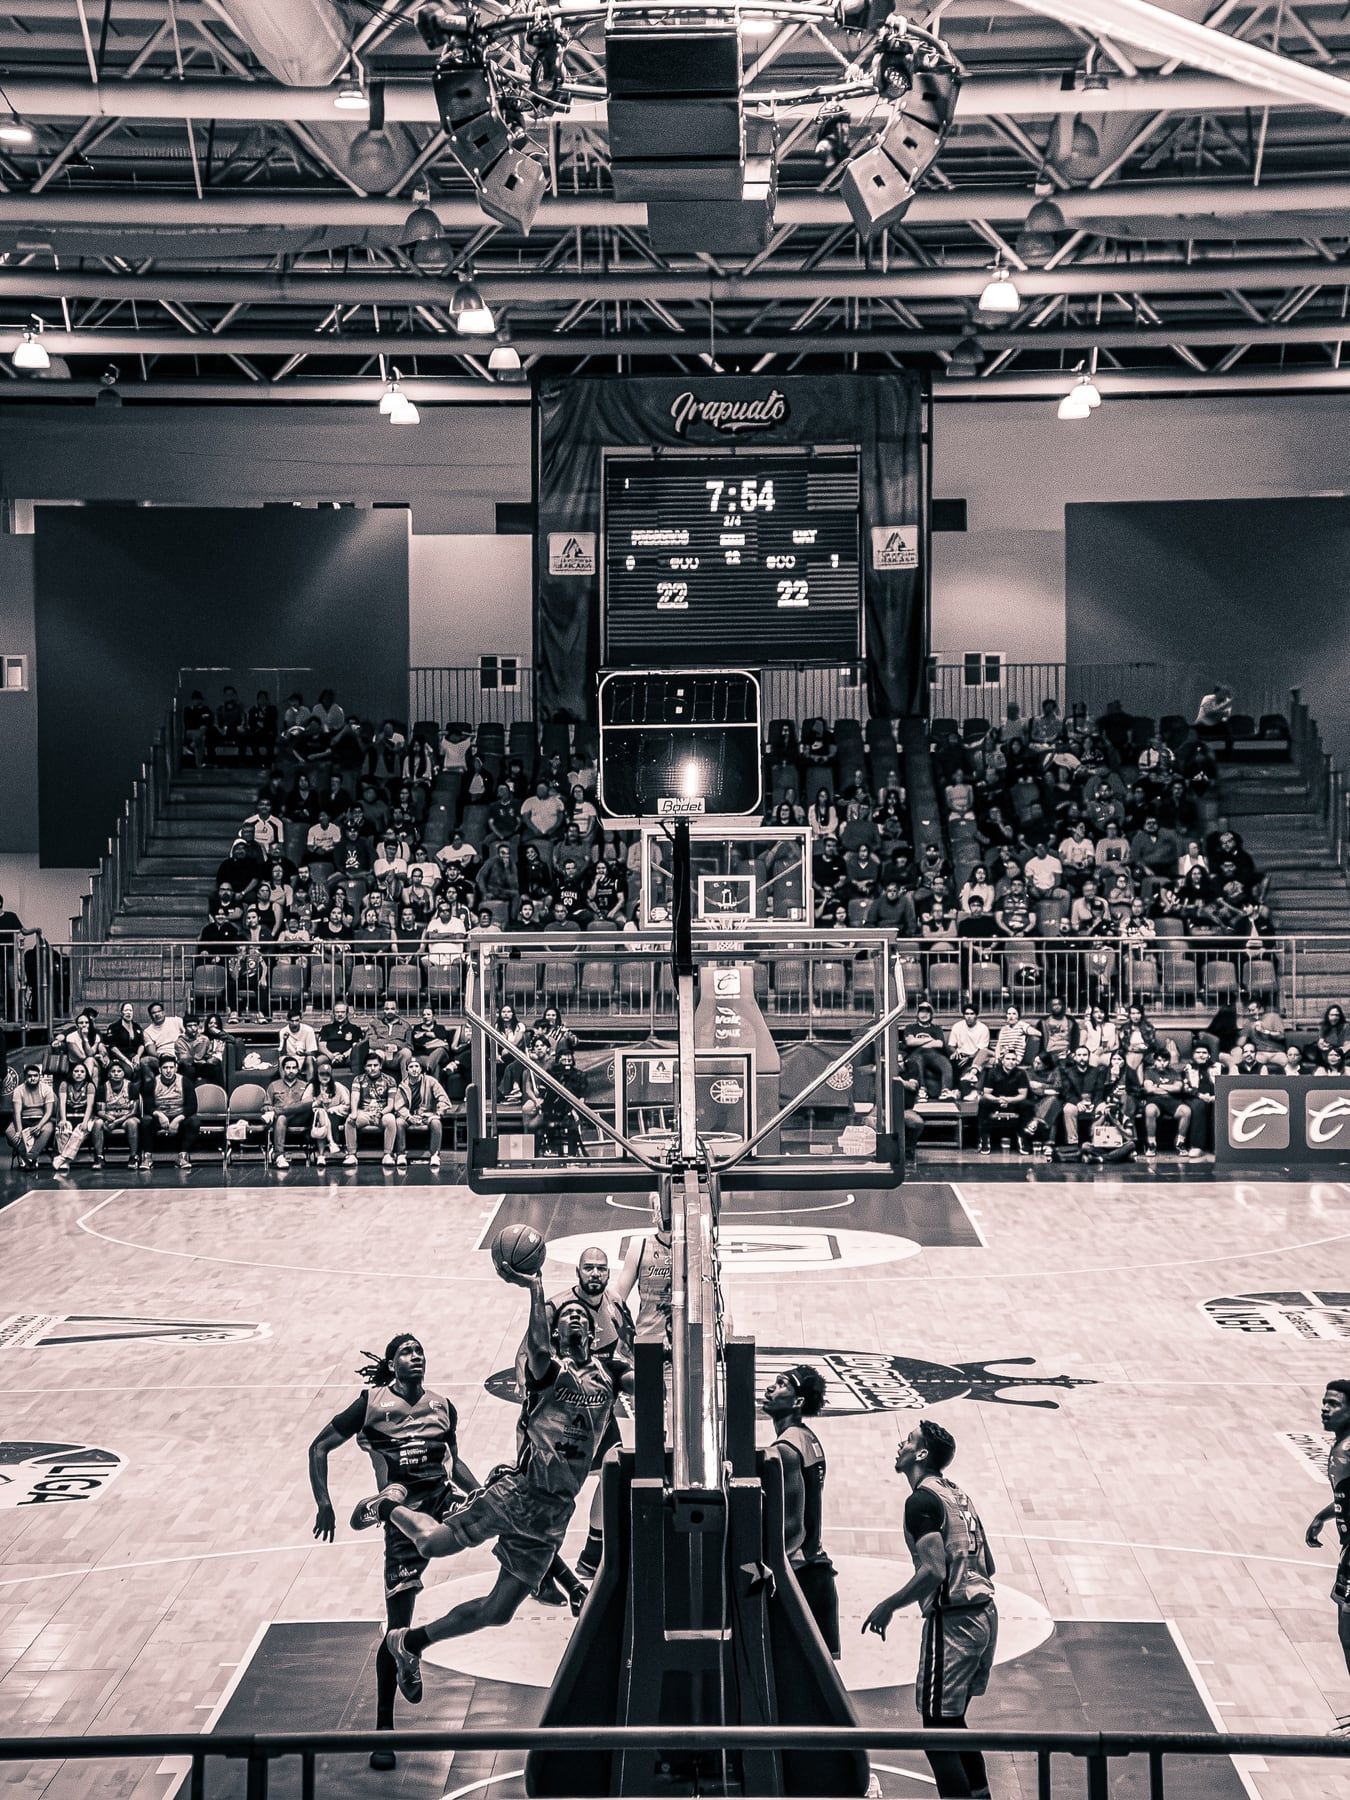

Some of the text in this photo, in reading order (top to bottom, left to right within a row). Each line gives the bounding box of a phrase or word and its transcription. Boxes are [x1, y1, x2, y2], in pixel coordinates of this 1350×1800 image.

[670, 389, 785, 432] Irapuato
[705, 480, 776, 512] 7:54
[656, 582, 689, 609] 22
[776, 580, 810, 608] 22
[662, 800, 702, 812] Bodet
[648, 1265, 672, 1278] Irap
[16, 1464, 118, 1506] LIGA
